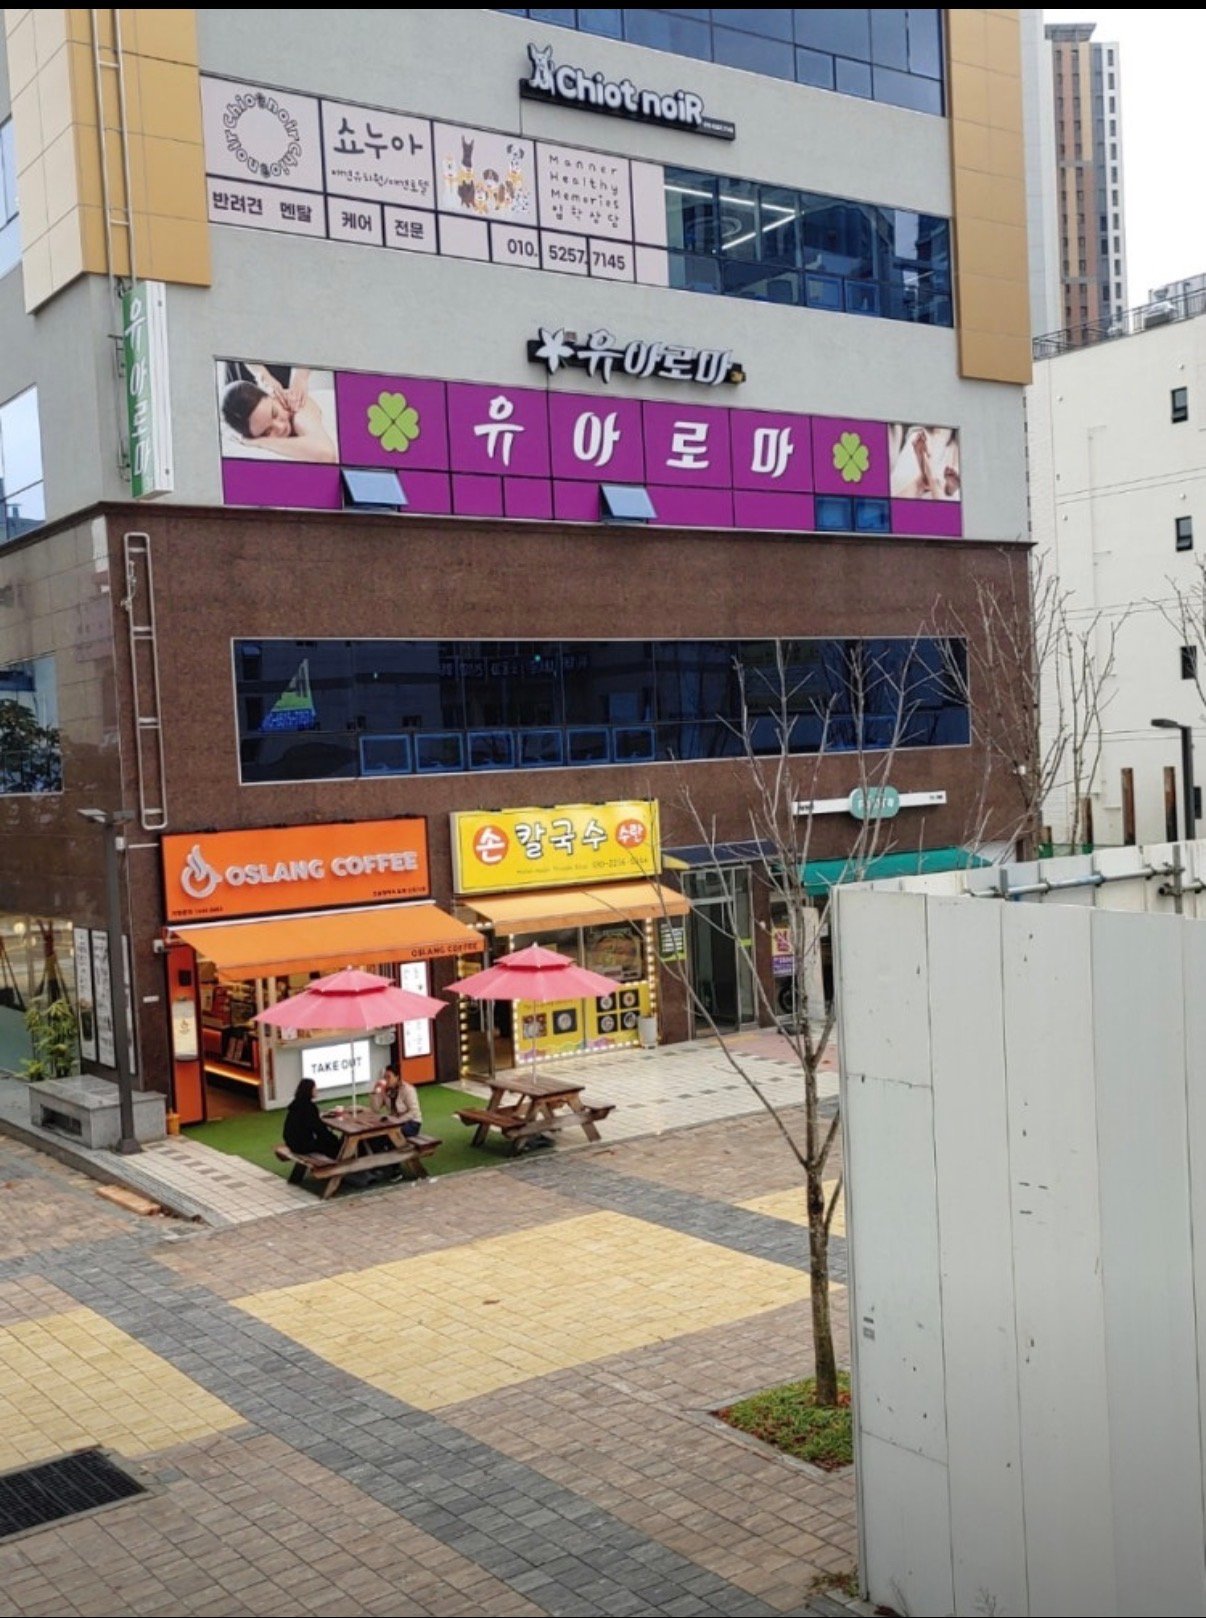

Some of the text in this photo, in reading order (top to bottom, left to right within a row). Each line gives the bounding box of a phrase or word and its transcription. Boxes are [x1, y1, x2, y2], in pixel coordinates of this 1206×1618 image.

[556, 65, 637, 112] Chiot
[333, 117, 423, 160] 쇼누아
[549, 154, 617, 174] Manner
[550, 171, 618, 196] Healthy
[551, 189, 619, 209] Memories
[212, 191, 424, 240] 반려견 멘탈 케어 전문
[592, 250, 626, 270] 7145
[576, 329, 732, 386] 유아로마
[475, 826, 506, 864] 손
[514, 818, 609, 861] 칼국수
[225, 850, 419, 887] OSLANG COFFEE
[448, 942, 478, 953] COFFEE
[311, 1056, 362, 1074] TAKE OUT
